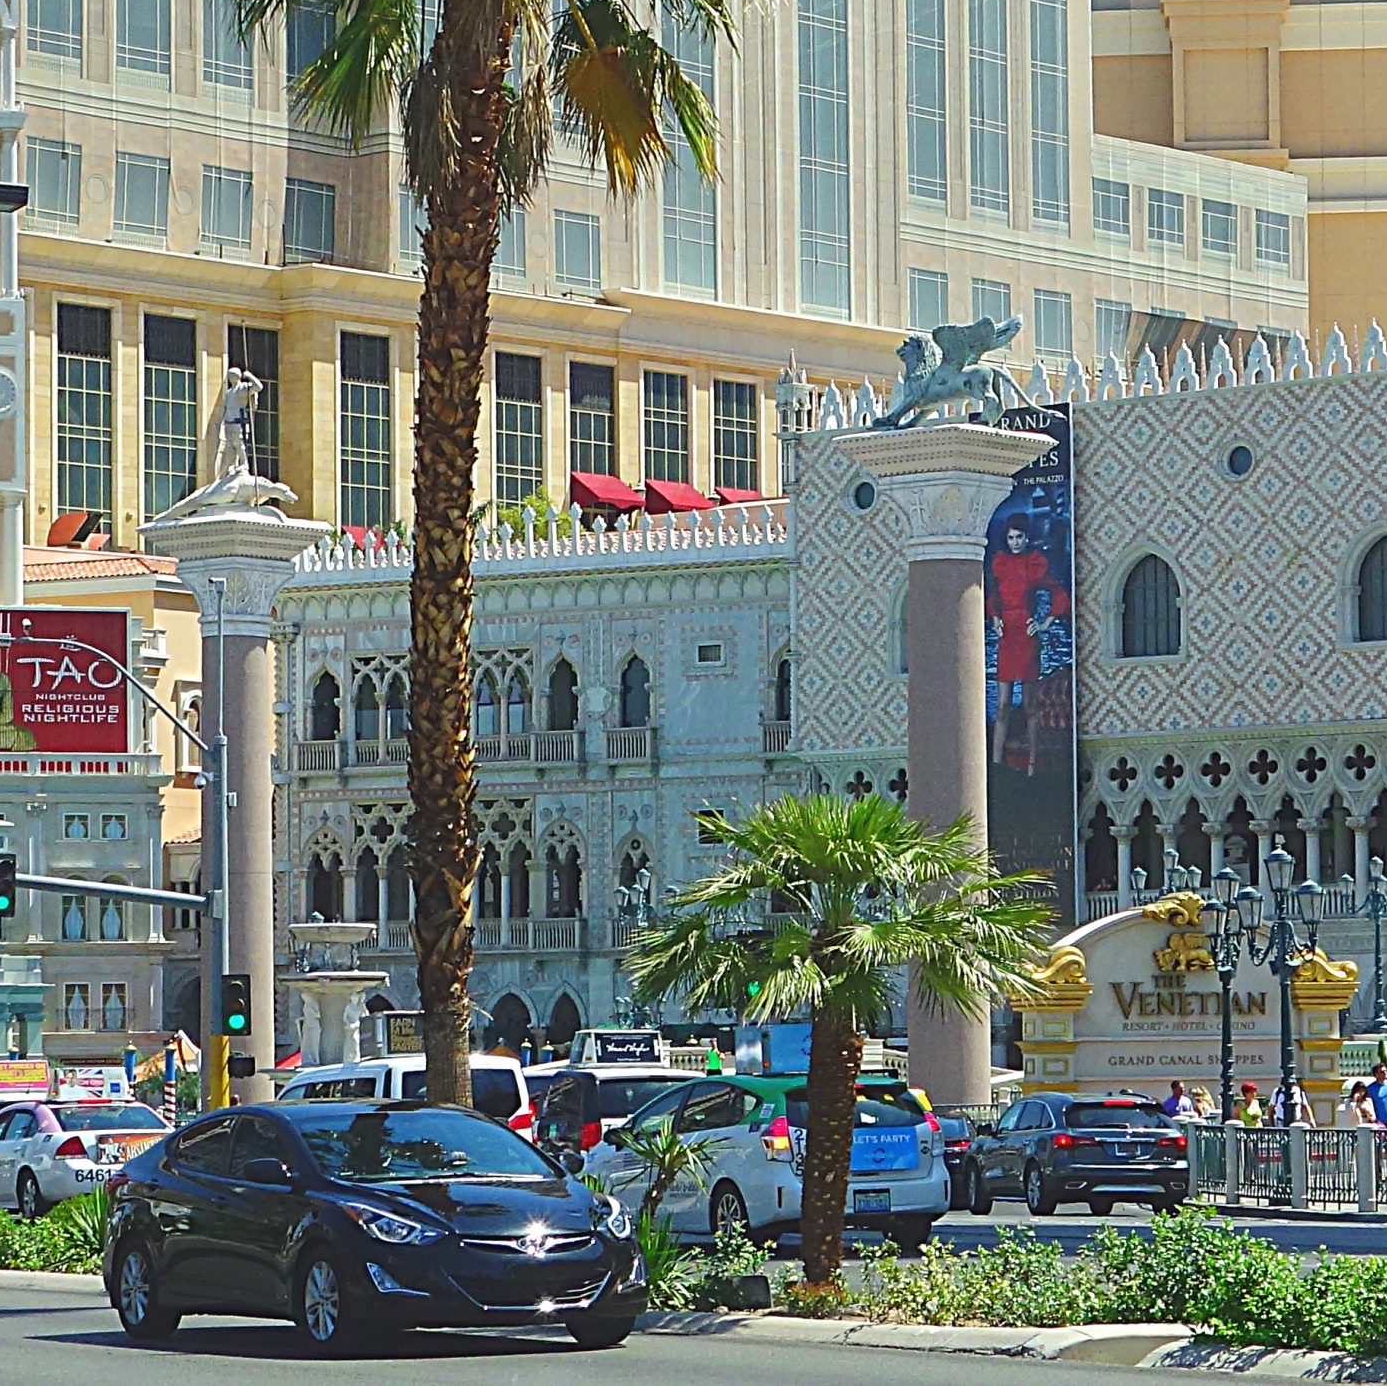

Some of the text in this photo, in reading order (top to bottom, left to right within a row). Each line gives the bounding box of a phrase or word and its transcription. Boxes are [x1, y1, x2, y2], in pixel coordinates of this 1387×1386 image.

[1001, 414, 1051, 430] RAND
[16, 656, 122, 690] TAO
[35, 693, 106, 701] NIGHTCLUB
[21, 704, 120, 714] RELIGIOUS
[23, 714, 118, 723] NIGHTLIFE
[1151, 974, 1187, 989] THE
[1108, 981, 1269, 1020] VENETIAN
[1122, 1021, 1256, 1032] RESORT HOTEL CSINO
[1108, 1054, 1264, 1066] GRAND CANAL SHPPES
[853, 1134, 911, 1145] LET'S PARTY
[794, 1129, 805, 1176] 2135
[75, 1168, 112, 1182] 6461
